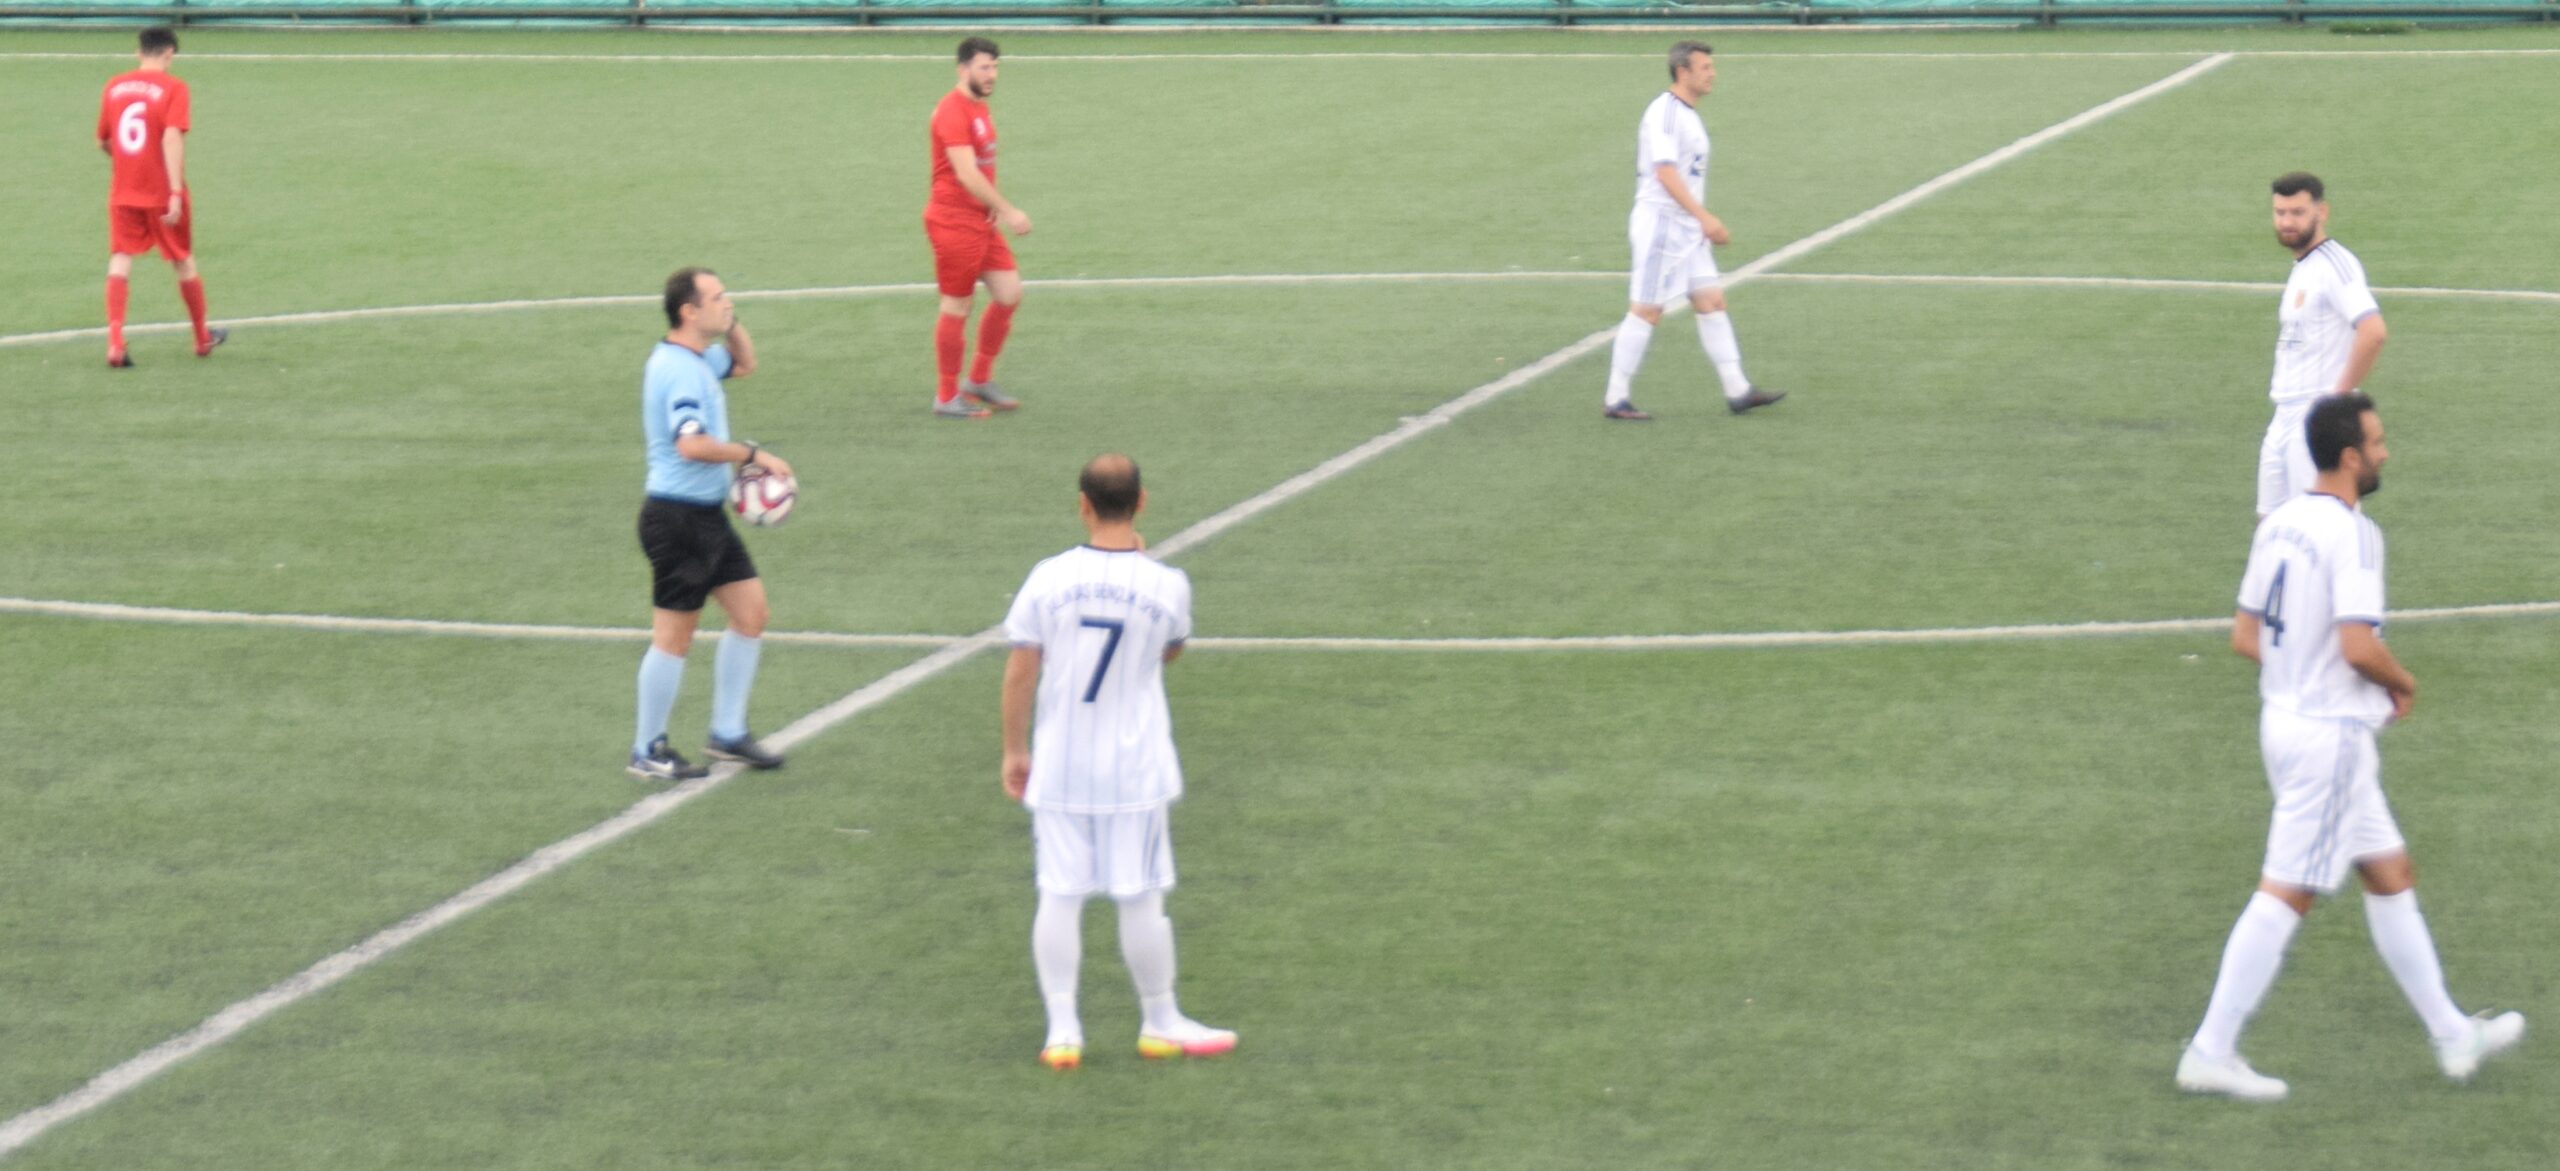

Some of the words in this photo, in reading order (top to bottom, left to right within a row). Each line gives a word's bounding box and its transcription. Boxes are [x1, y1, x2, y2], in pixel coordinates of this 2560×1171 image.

[118, 101, 147, 153] 6
[2264, 559, 2285, 646] 4
[1079, 615, 1124, 702] 7
